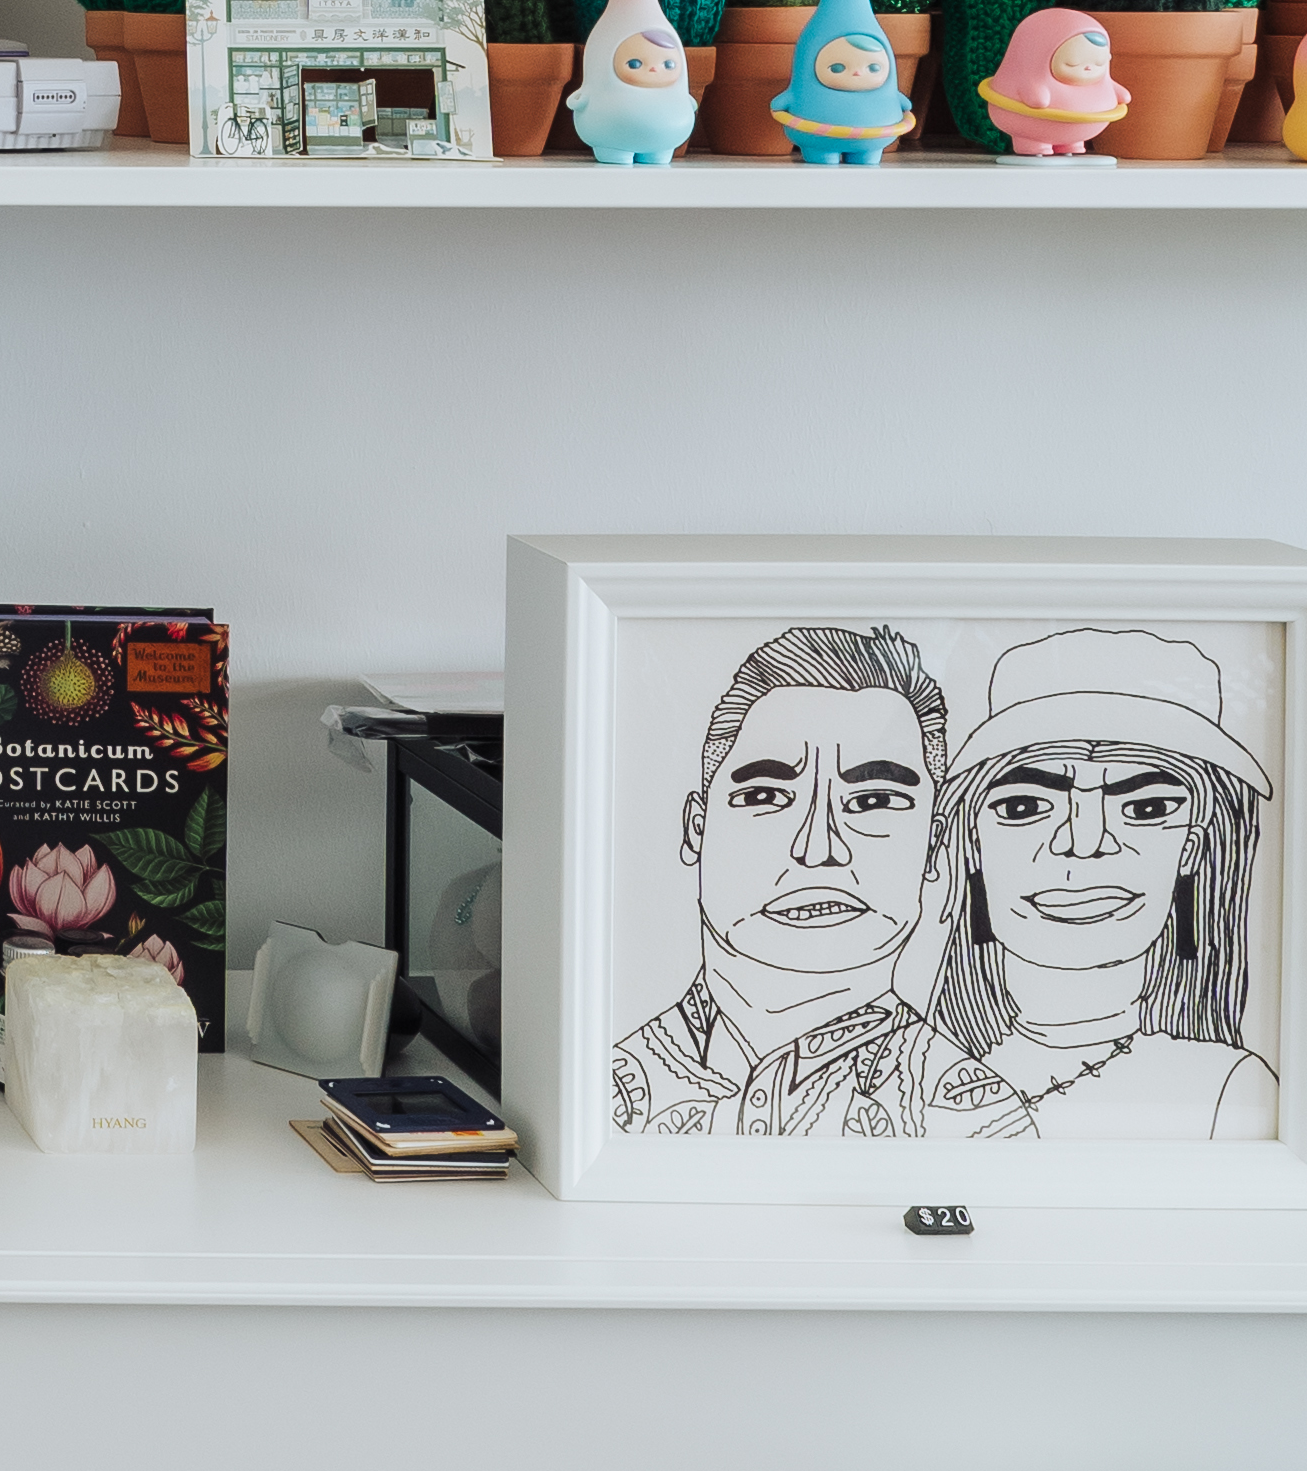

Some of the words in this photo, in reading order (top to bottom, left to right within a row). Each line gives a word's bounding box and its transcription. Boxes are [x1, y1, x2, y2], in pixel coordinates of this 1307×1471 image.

[133, 647, 196, 661] Welcome
[153, 662, 166, 672] to
[173, 662, 195, 672] the
[133, 670, 197, 684] Museum
[40, 800, 51, 810] by
[55, 799, 91, 809] KATIE
[96, 800, 137, 810] SCOTT
[13, 812, 30, 821] and
[34, 812, 75, 822] KATHY
[80, 812, 121, 823] WILLIS
[92, 1117, 148, 1130] HYANG
